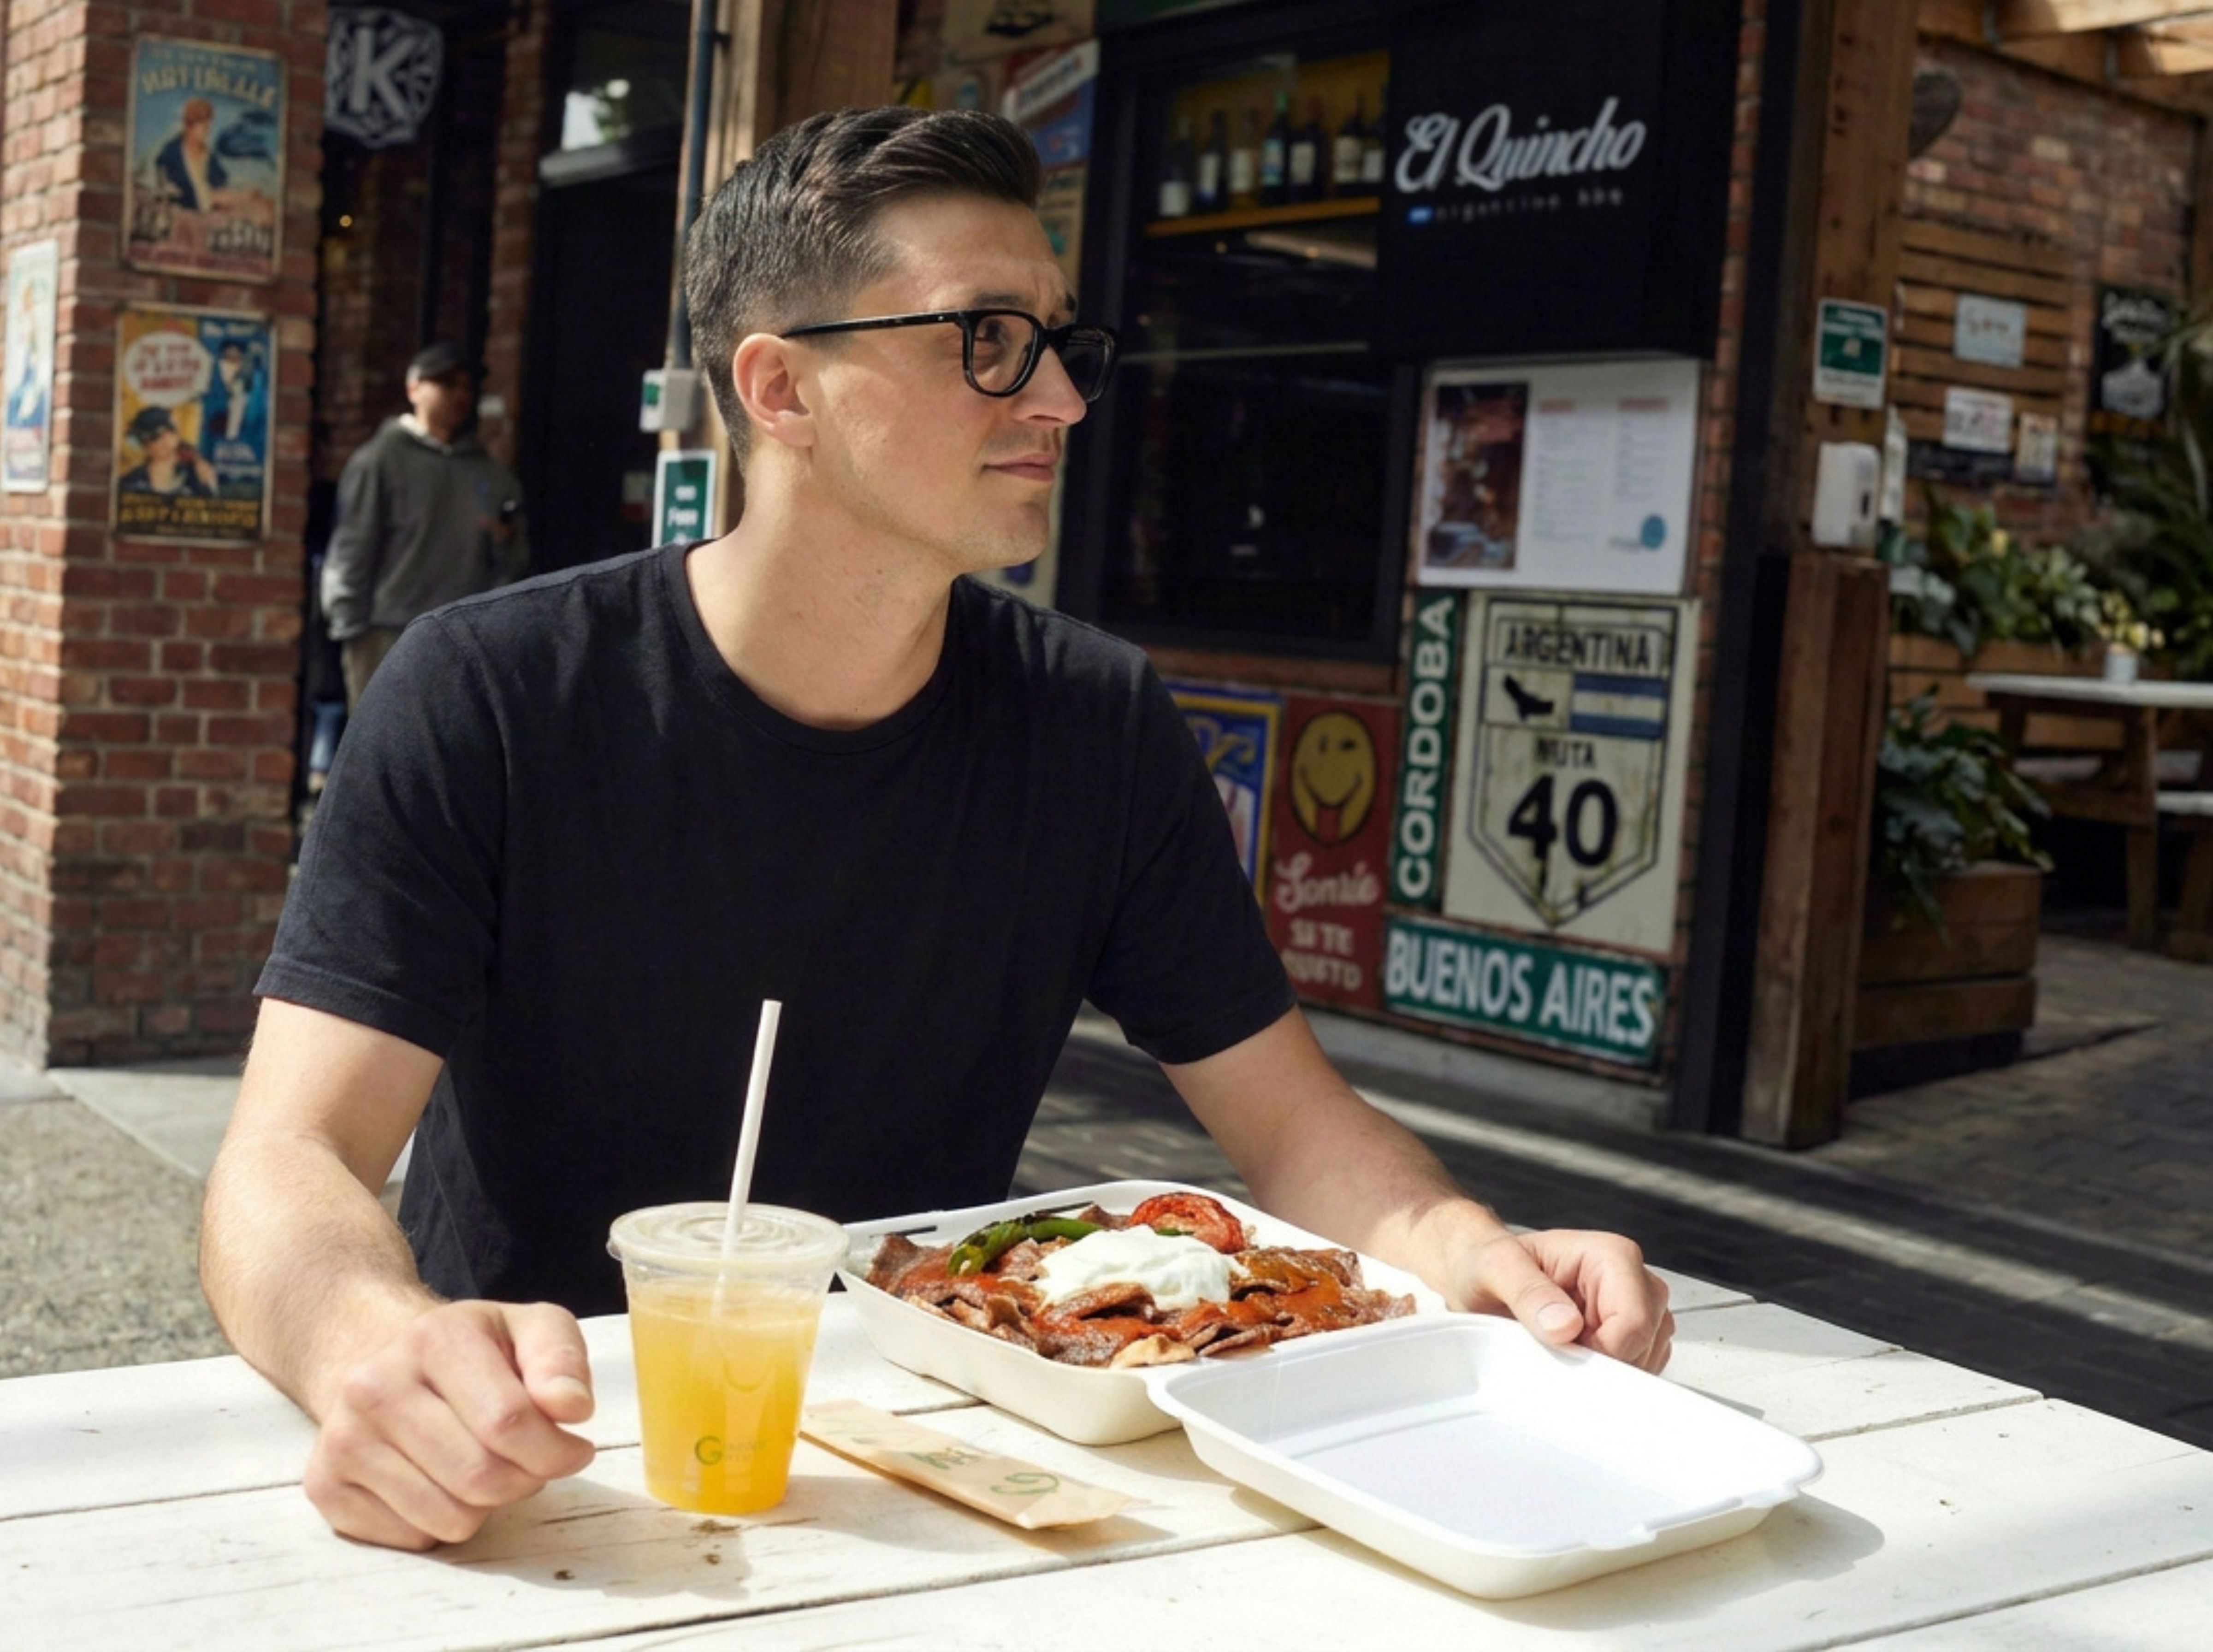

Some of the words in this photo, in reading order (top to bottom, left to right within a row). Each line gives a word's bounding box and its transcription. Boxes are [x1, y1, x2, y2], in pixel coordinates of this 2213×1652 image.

[1395, 112, 1460, 193] El
[1456, 95, 1647, 192] Quincho
[1504, 627, 1650, 671] ARGENTINA
[1397, 597, 1454, 898] CORDOBA
[1508, 774, 1618, 867] 40
[1320, 922, 1354, 956] TE
[1385, 927, 1534, 1024] BUENOS
[1538, 962, 1657, 1049] AIRES
